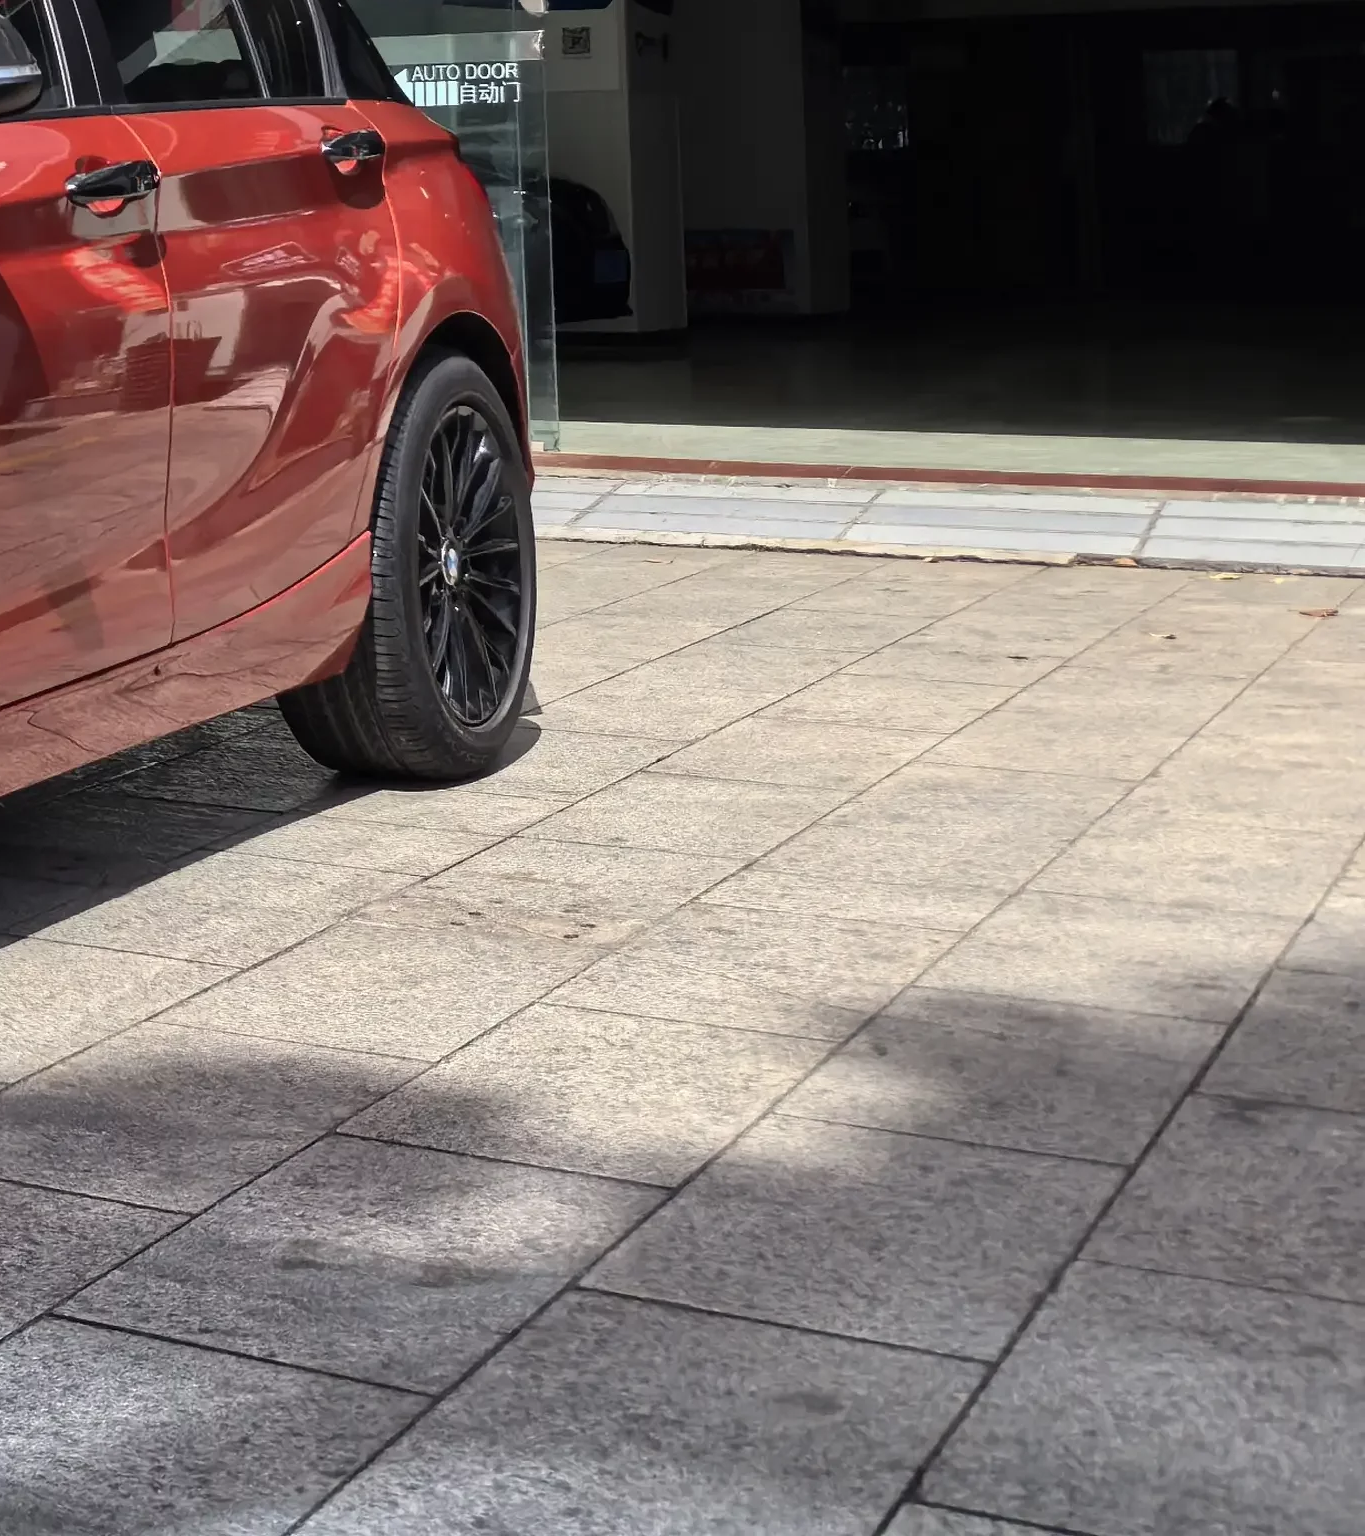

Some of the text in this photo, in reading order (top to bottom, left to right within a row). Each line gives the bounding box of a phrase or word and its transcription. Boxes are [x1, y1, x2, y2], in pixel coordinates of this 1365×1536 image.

[411, 62, 519, 81] AUTO DOOR
[459, 81, 521, 105] 自动门
